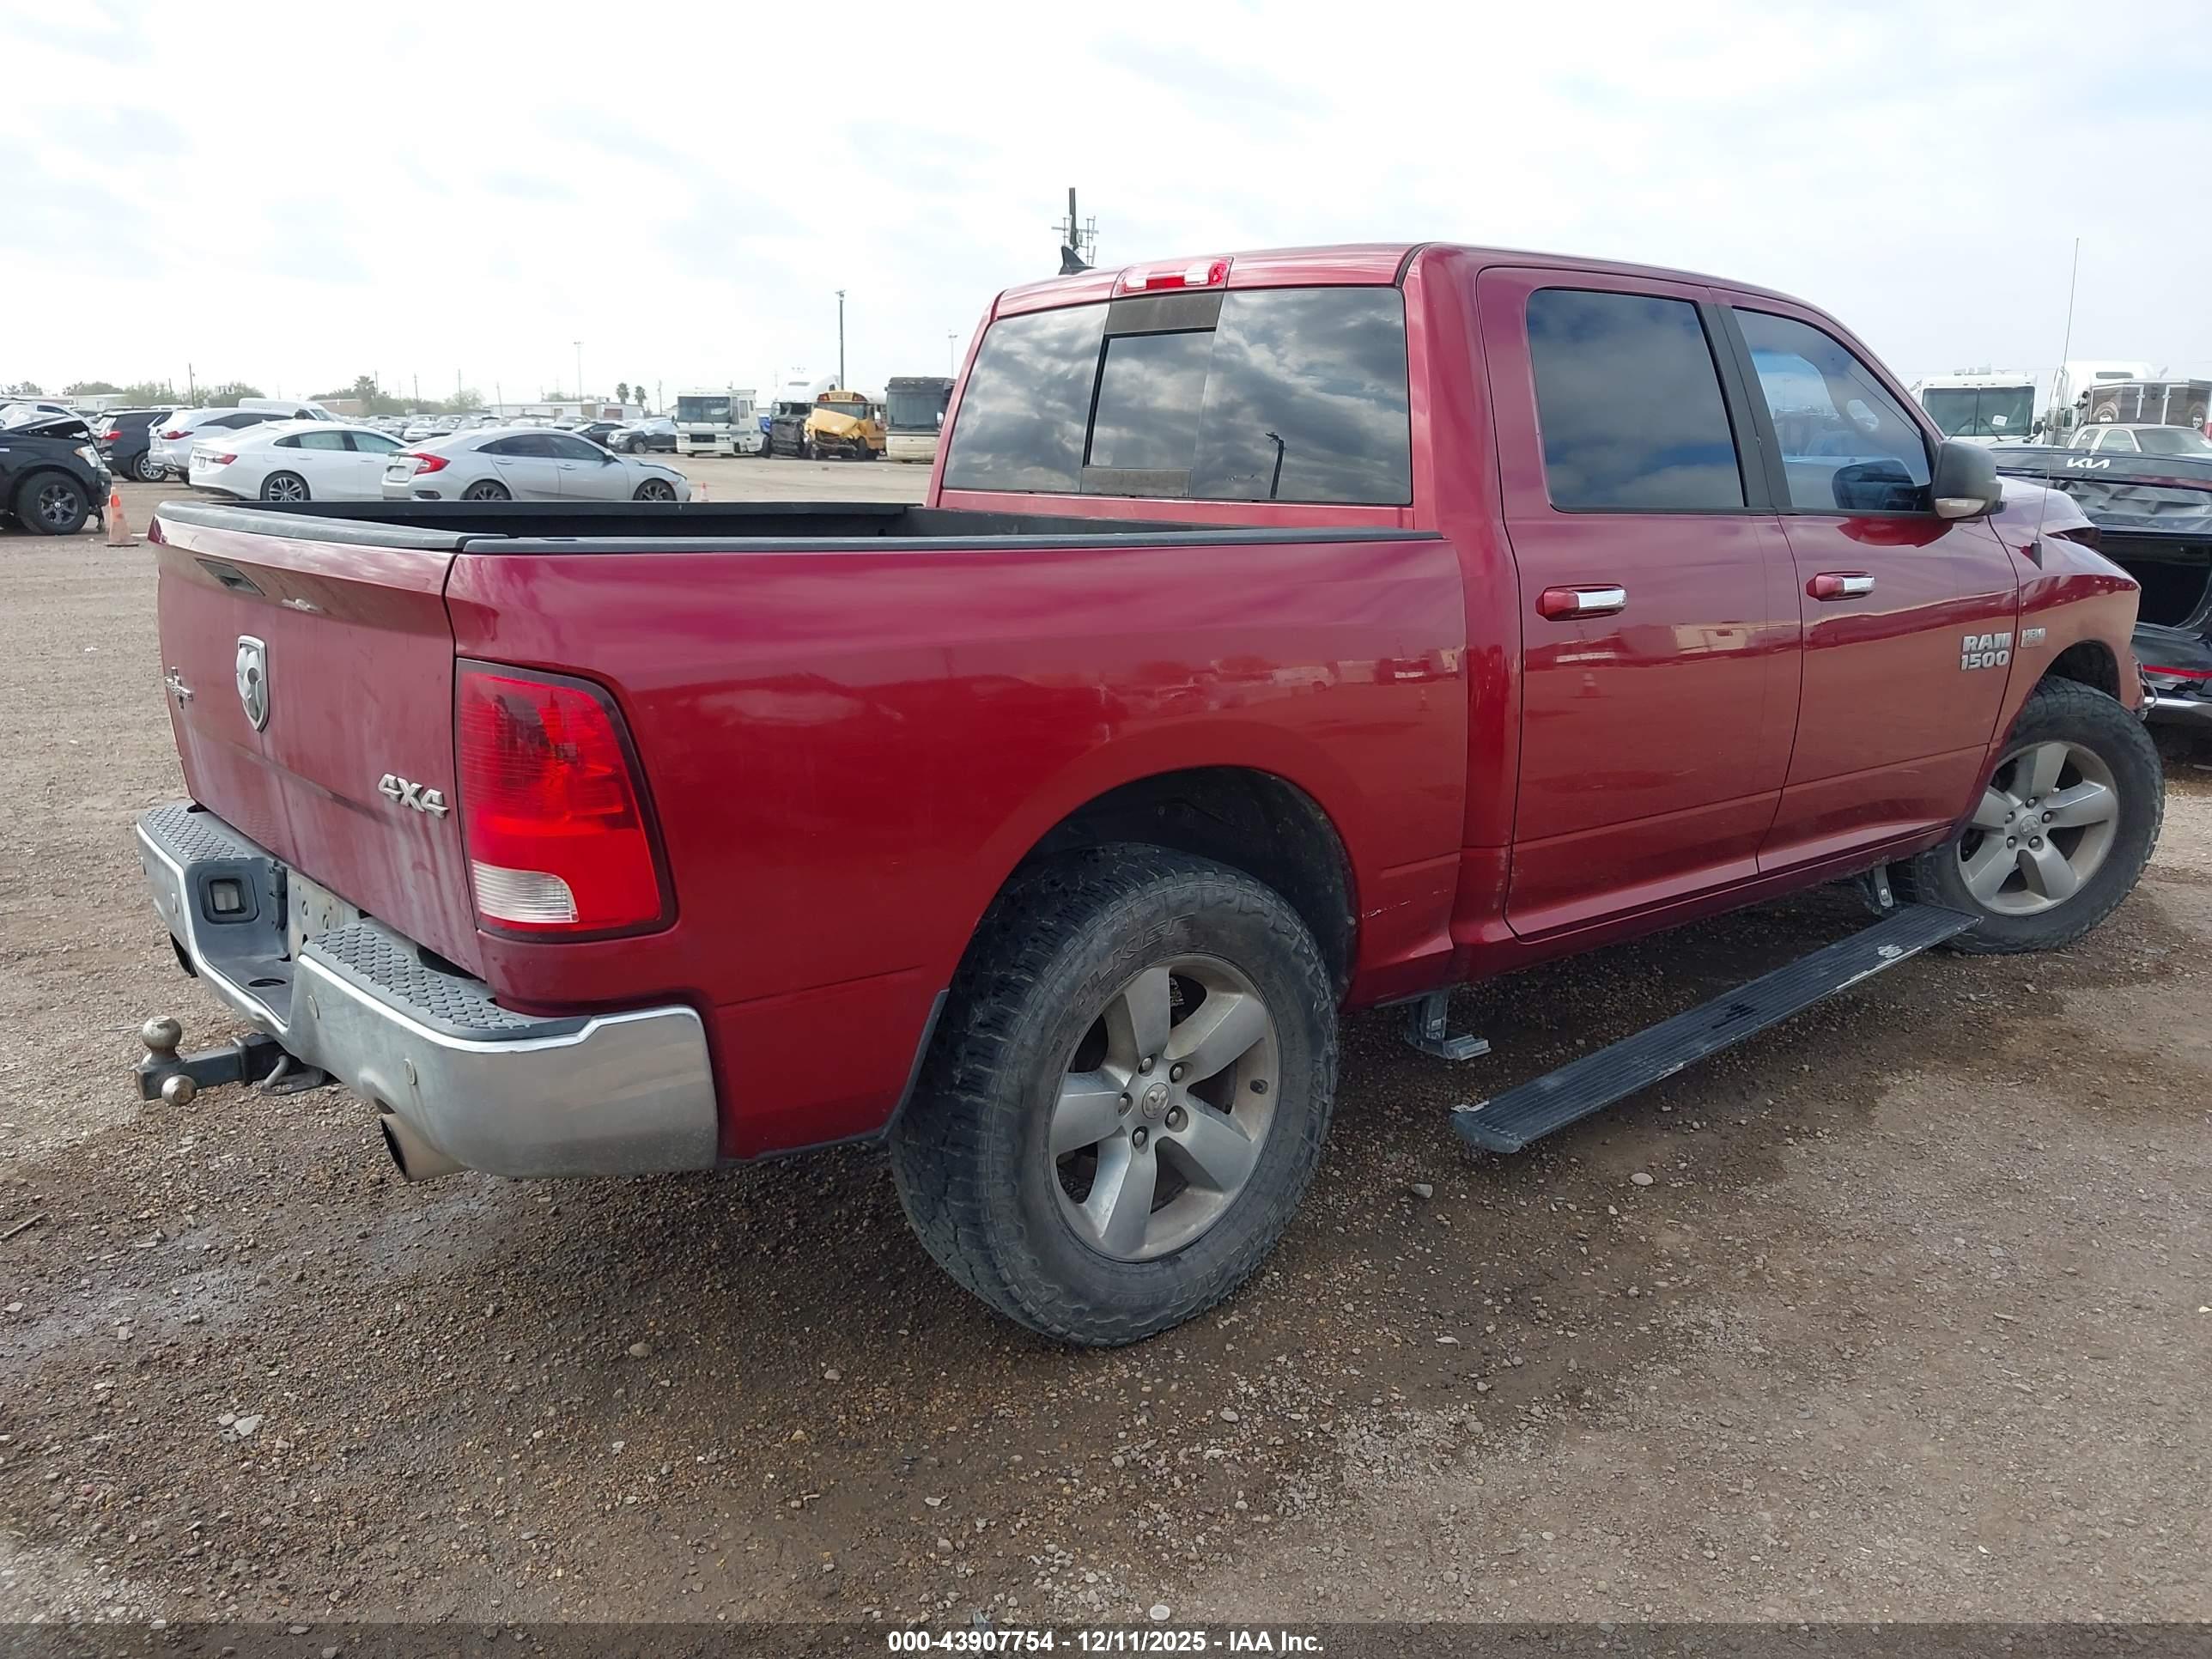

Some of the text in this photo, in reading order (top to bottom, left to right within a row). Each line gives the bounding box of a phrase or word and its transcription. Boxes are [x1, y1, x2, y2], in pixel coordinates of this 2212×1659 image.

[2066, 457, 2111, 470] KIA
[1962, 632, 2012, 653] RAM
[1960, 650, 2010, 671] 1500
[378, 773, 449, 819] 4X4
